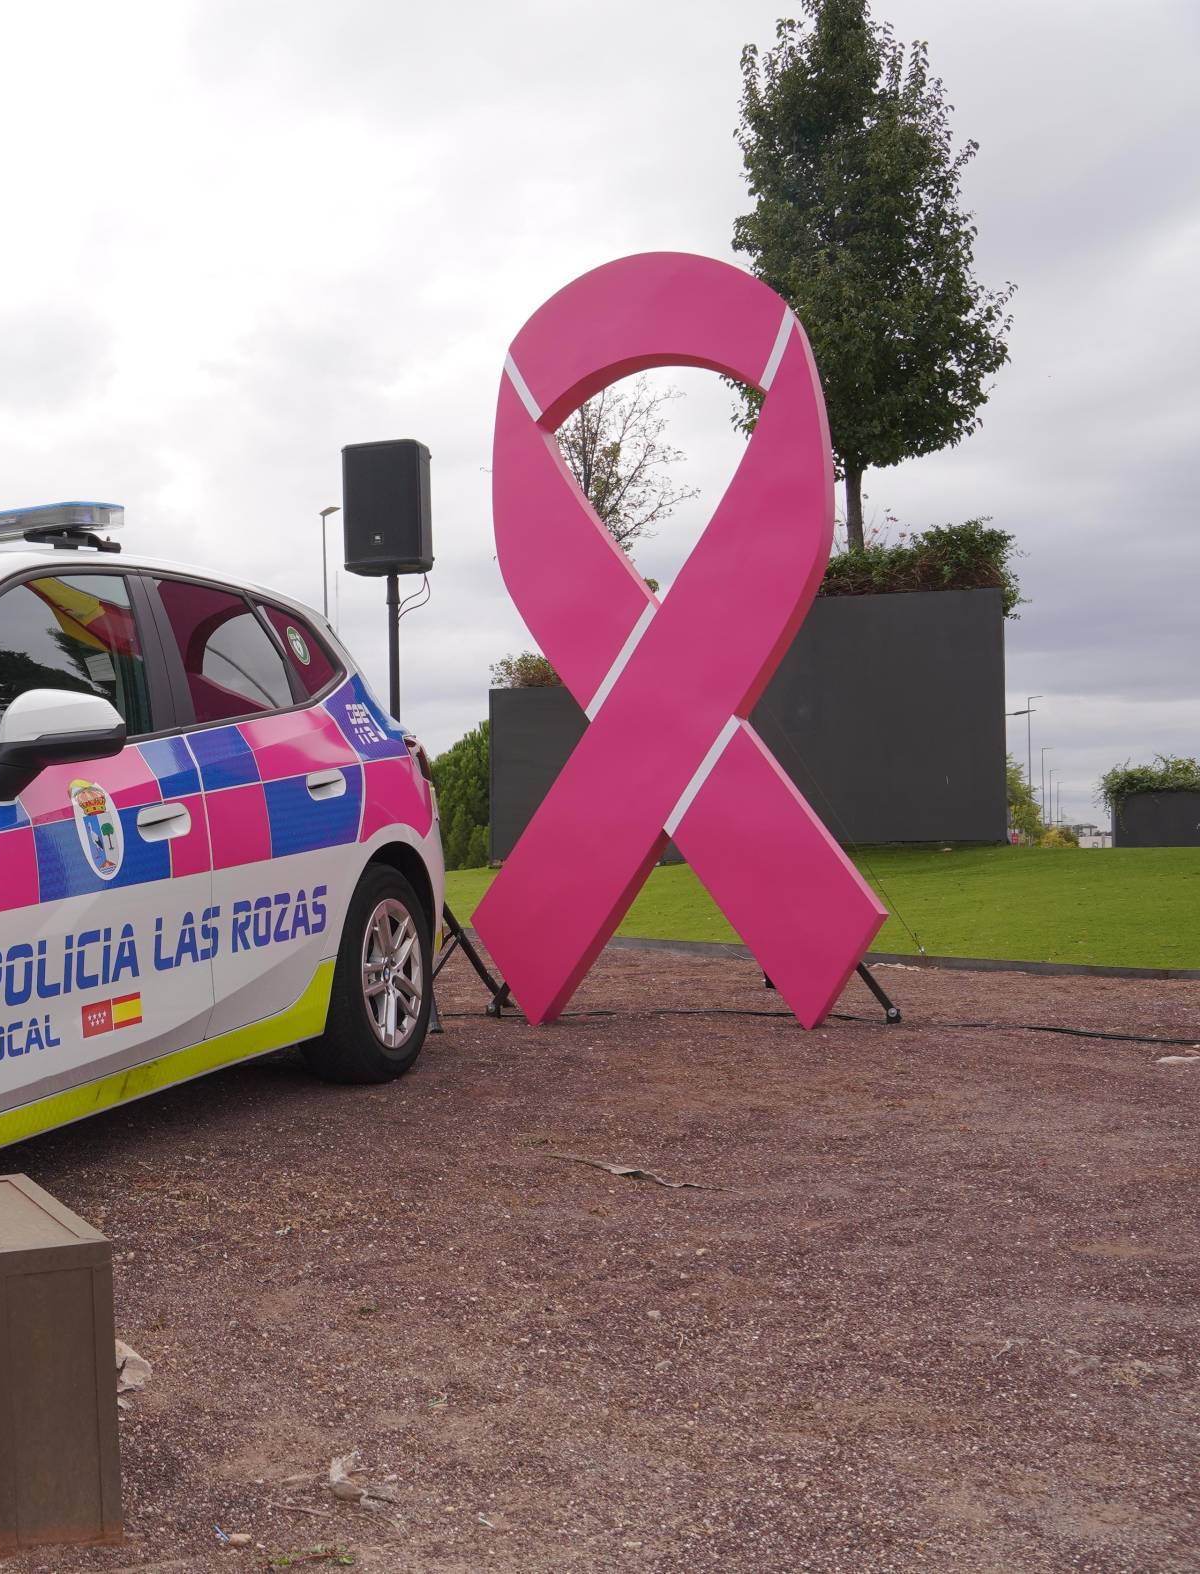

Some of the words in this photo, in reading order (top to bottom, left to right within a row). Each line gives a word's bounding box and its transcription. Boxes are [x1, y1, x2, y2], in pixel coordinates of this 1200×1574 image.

[355, 726, 379, 745] 112
[153, 906, 221, 972] LAS
[231, 885, 328, 953] ROZAS
